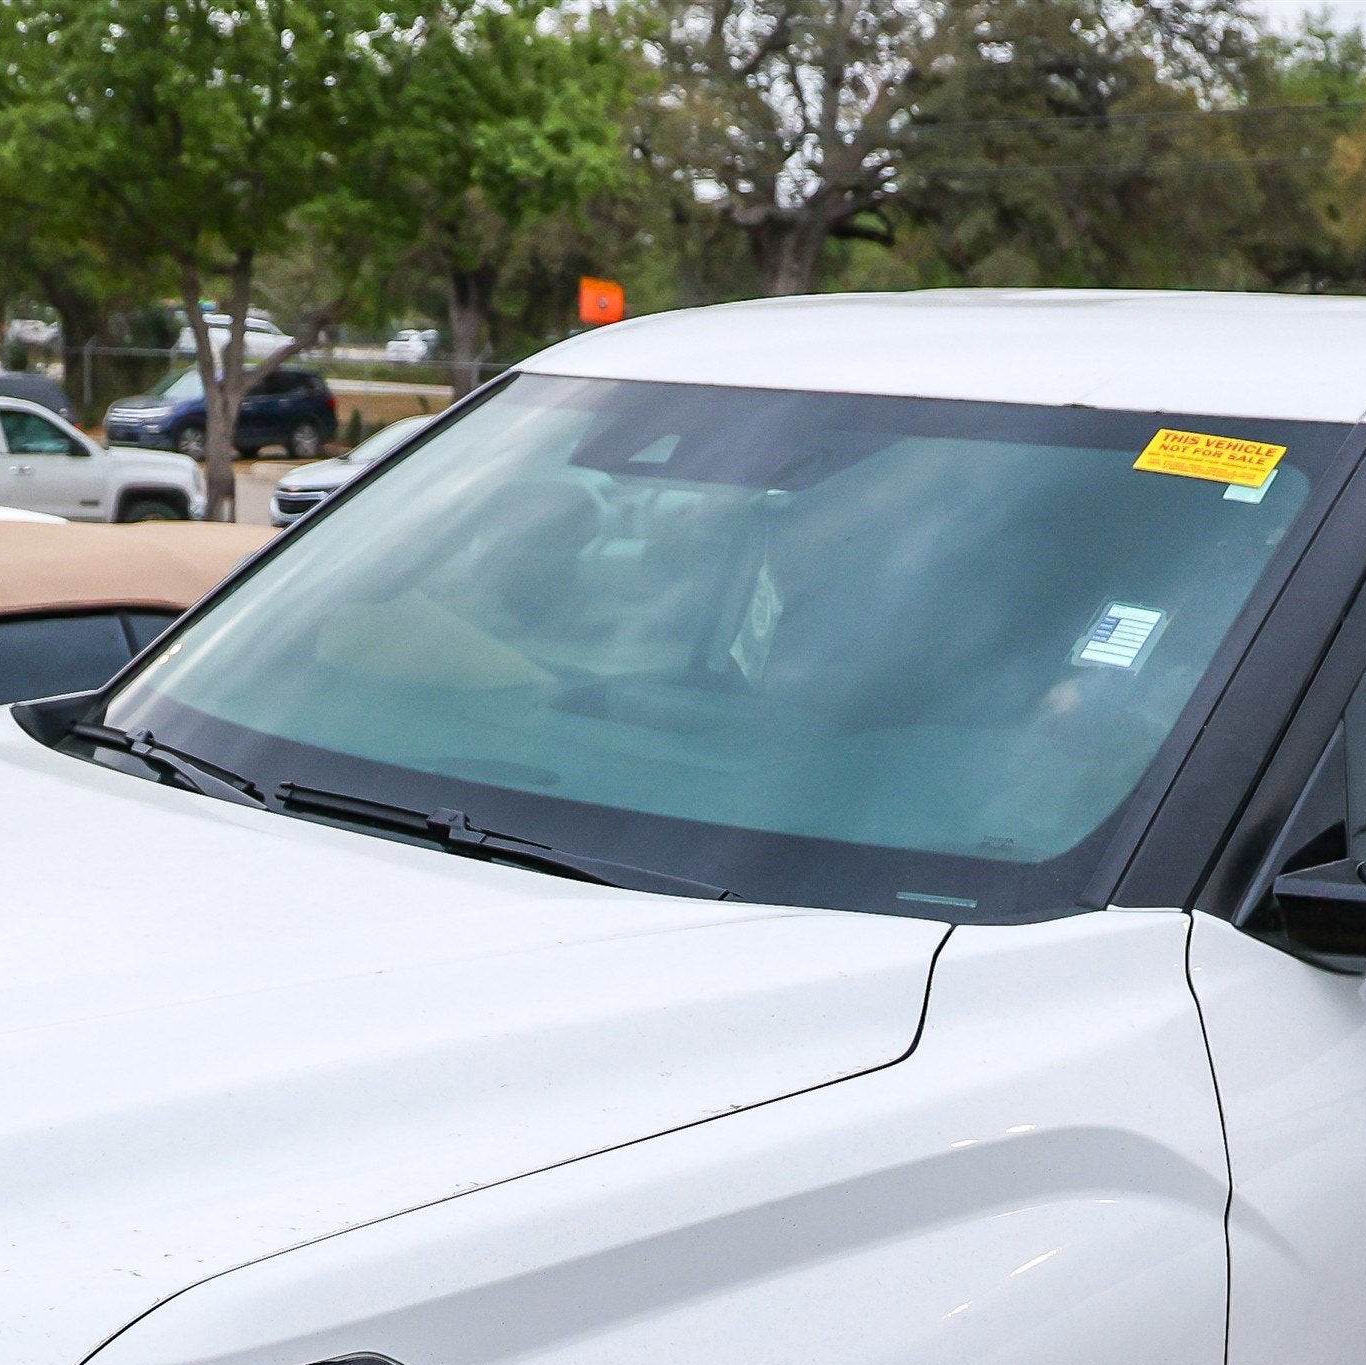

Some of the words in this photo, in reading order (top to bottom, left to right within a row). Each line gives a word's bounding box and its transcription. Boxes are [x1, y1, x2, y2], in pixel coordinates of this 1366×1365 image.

[1159, 443, 1186, 454] NOT
[1192, 447, 1223, 459] FOR
[1227, 454, 1267, 466] SALE
[1163, 432, 1200, 445] THIS
[1205, 438, 1278, 458] VEHICLE
